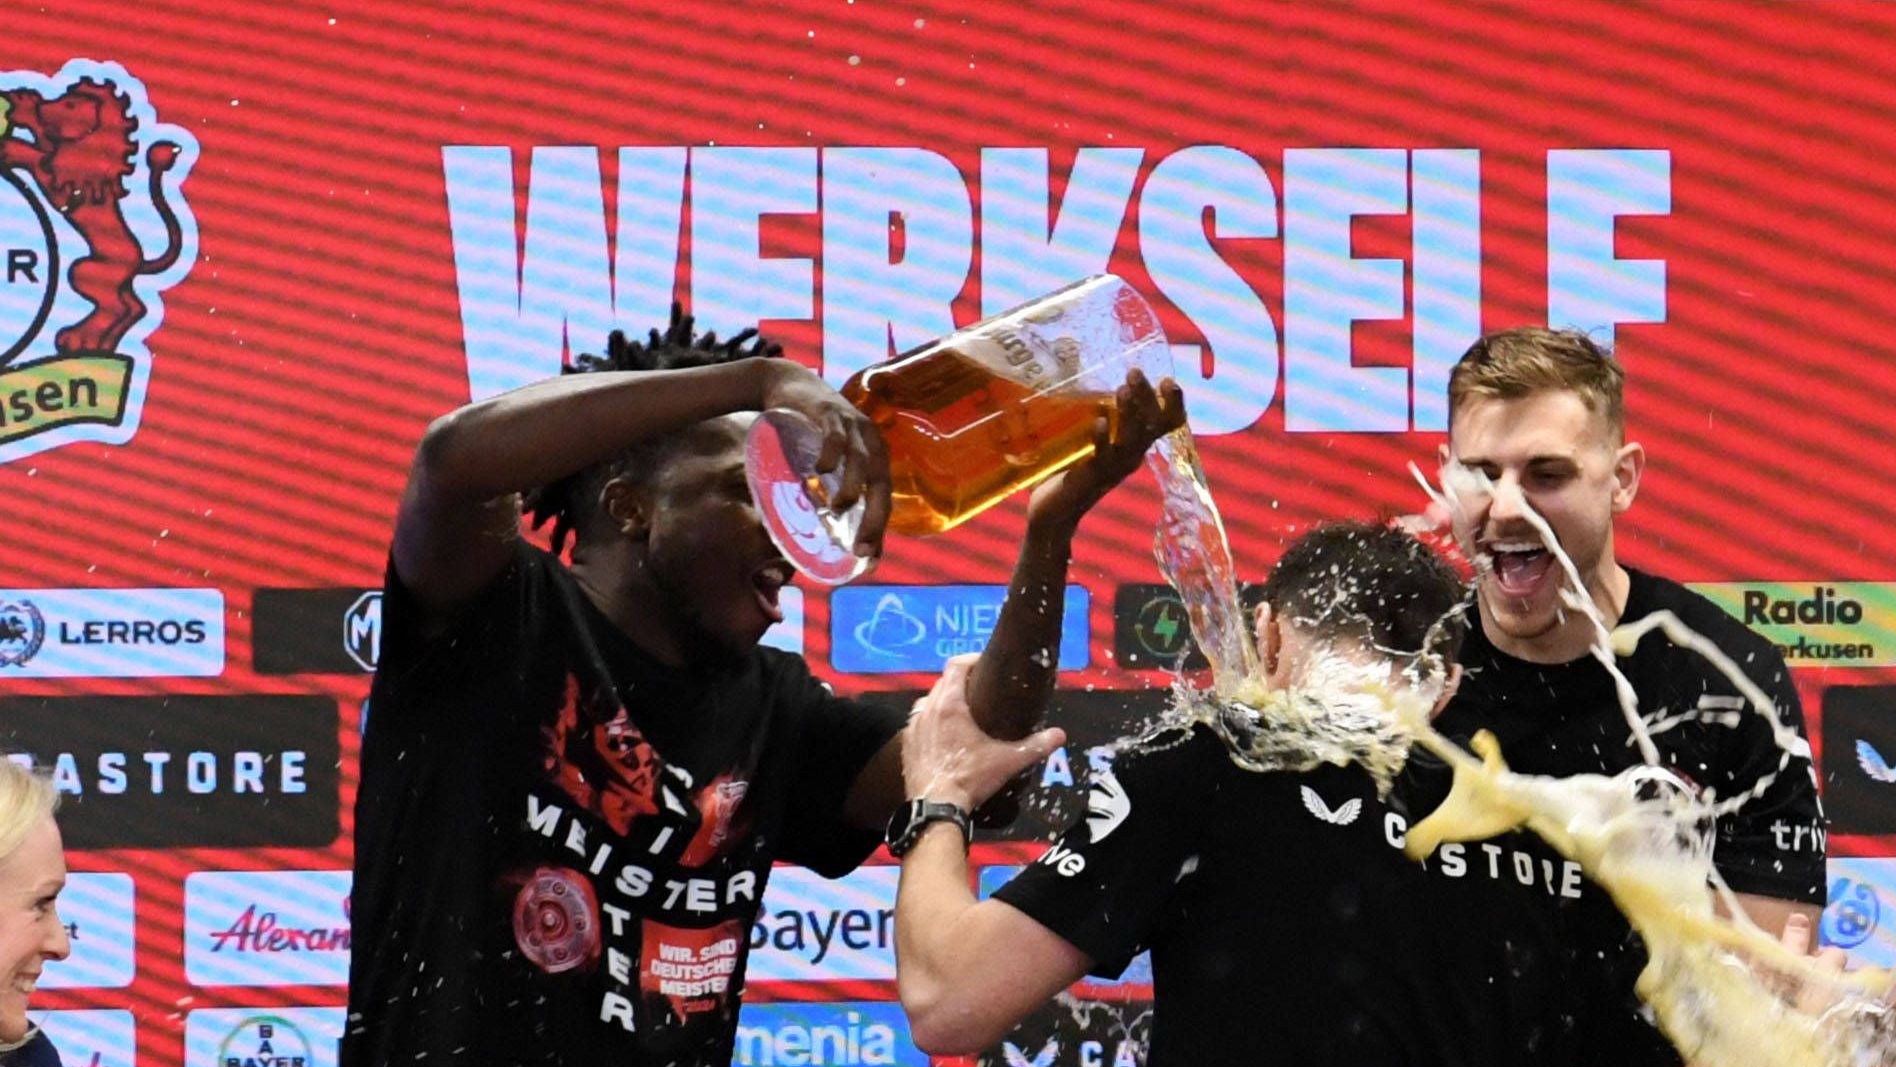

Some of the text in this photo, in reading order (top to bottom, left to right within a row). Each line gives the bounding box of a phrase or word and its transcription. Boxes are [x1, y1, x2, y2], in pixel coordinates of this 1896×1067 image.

[441, 146, 1672, 433] WERKSELF
[1744, 587, 1863, 625] Radio
[60, 620, 206, 644] LERROS
[1775, 636, 1874, 659] erkusen
[12, 752, 307, 793] ASTORE
[1384, 811, 1583, 898] CSTORE
